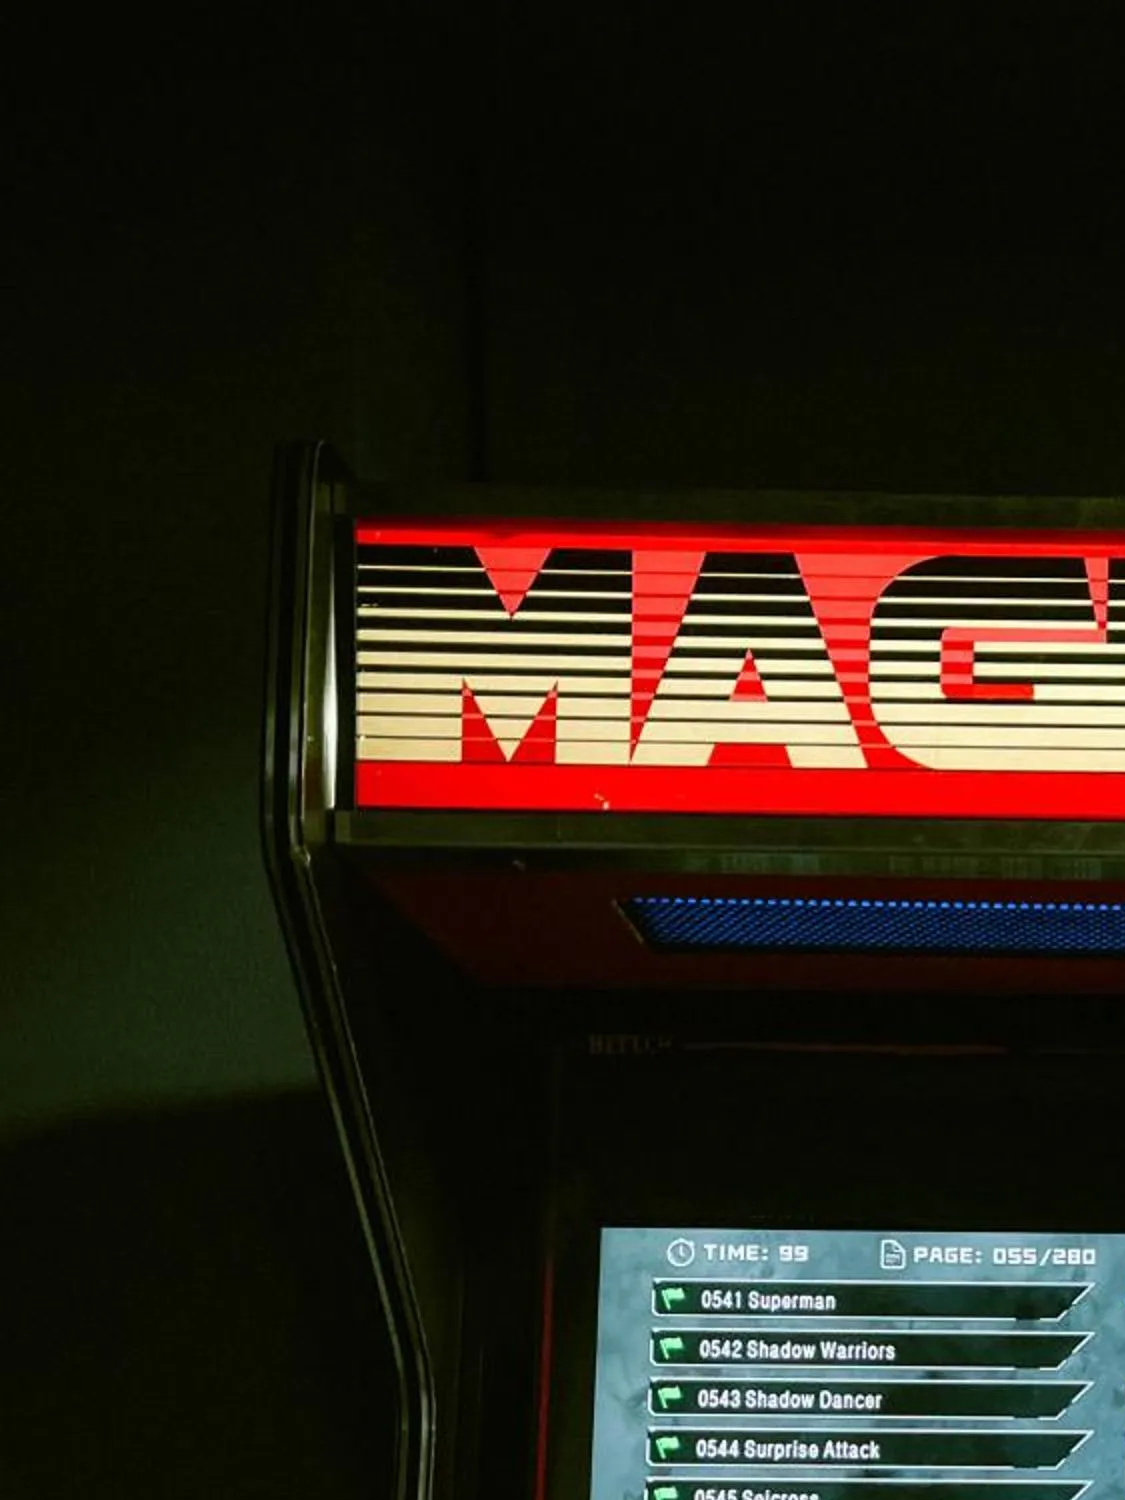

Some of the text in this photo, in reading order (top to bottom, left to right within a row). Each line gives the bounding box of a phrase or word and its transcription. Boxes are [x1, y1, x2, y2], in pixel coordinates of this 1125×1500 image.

[703, 1244, 809, 1262] TIME: 99
[913, 1247, 1096, 1266] PAGE: 055/280
[701, 1290, 836, 1315] 0541 Superman
[699, 1340, 896, 1361] 0542 Shadow Warriors
[697, 1389, 883, 1410] 0543 Shadow Dancer
[696, 1439, 880, 1464] 0544 Surprise Attack
